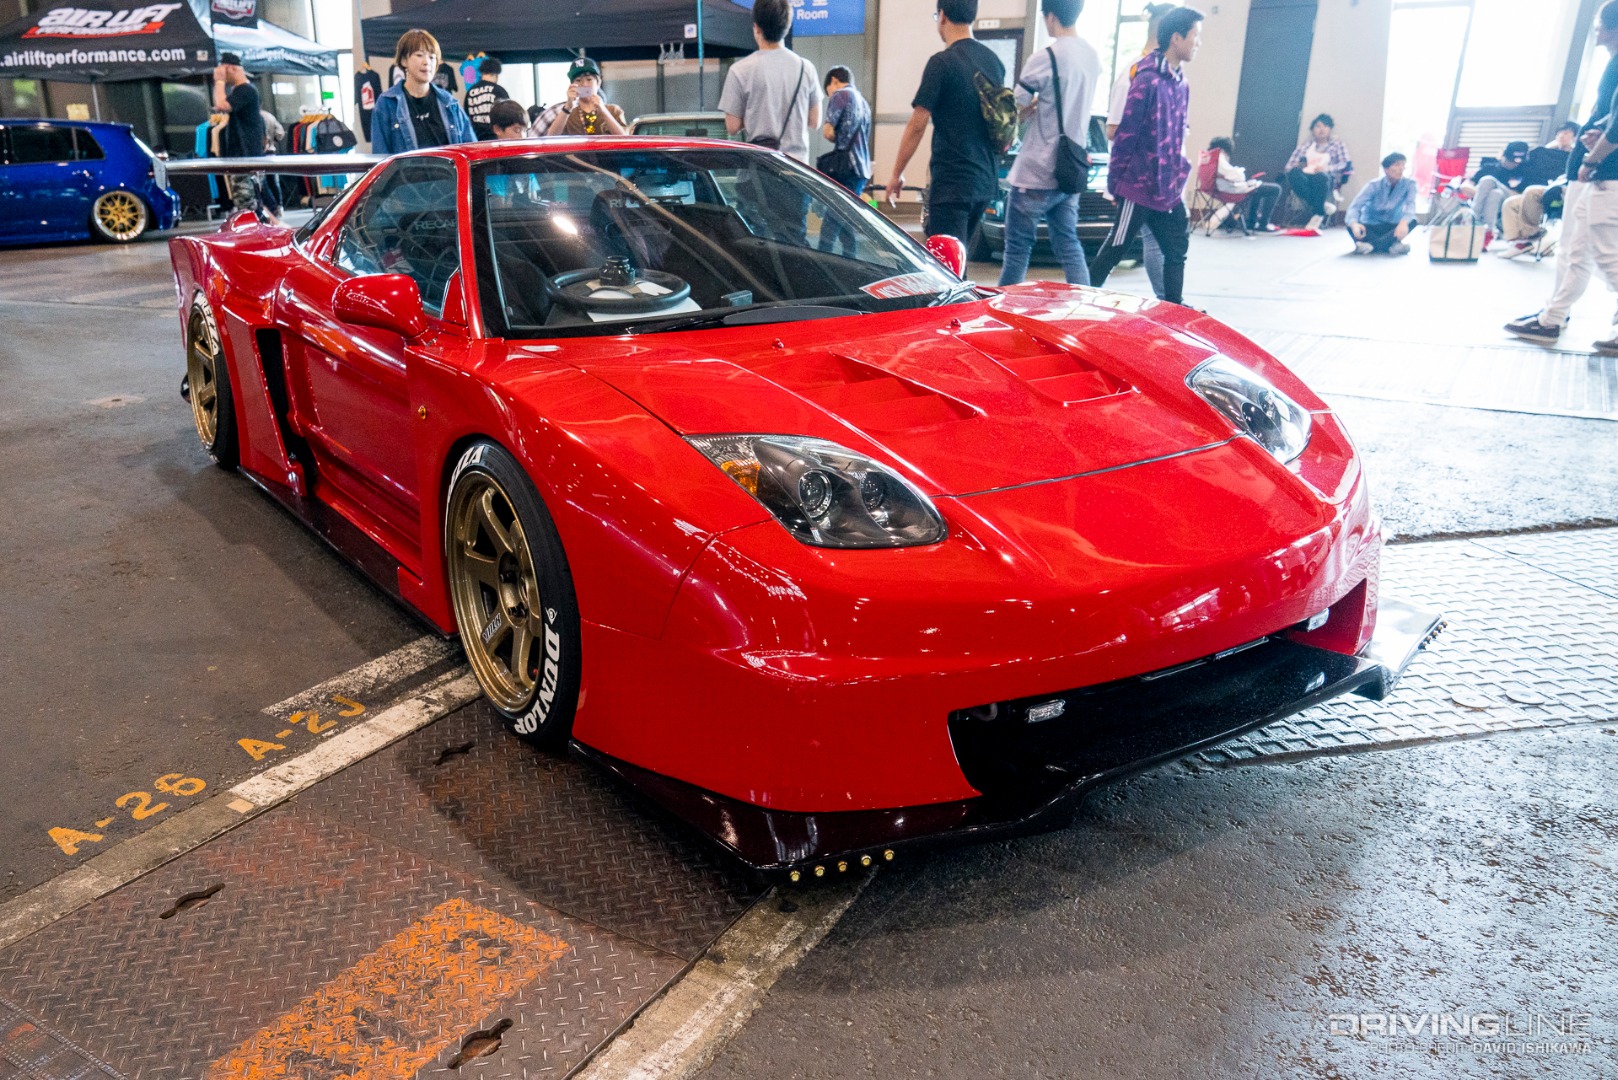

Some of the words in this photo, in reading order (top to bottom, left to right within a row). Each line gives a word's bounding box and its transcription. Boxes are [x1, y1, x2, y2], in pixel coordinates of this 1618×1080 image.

[796, 9, 829, 20] Room
[514, 623, 560, 735] DUNLOP
[48, 773, 207, 856] A-26
